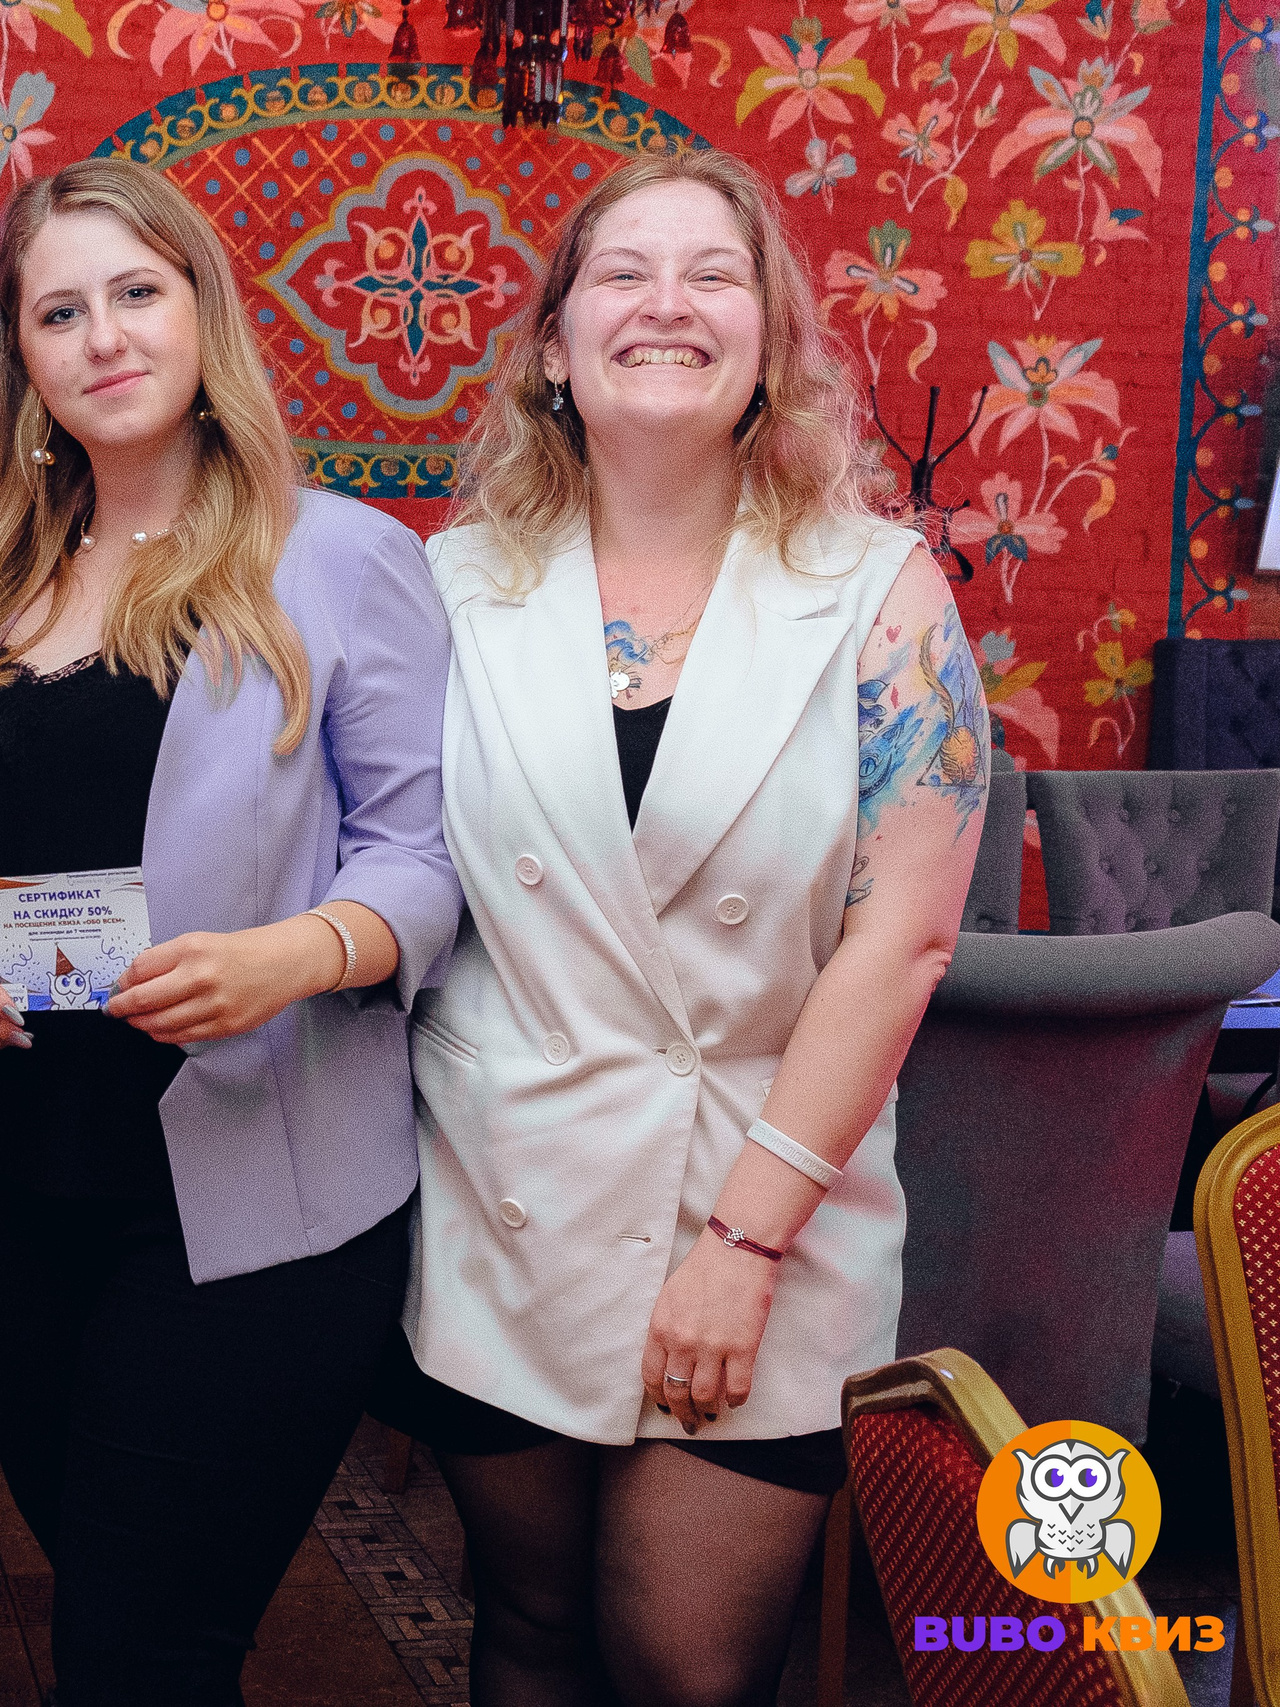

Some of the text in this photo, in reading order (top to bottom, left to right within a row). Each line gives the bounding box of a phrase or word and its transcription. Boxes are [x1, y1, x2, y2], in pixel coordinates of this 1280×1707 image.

[18, 889, 101, 903] СЕРТИФИКАТ
[13, 906, 113, 920] НА СКИДКУ 50%
